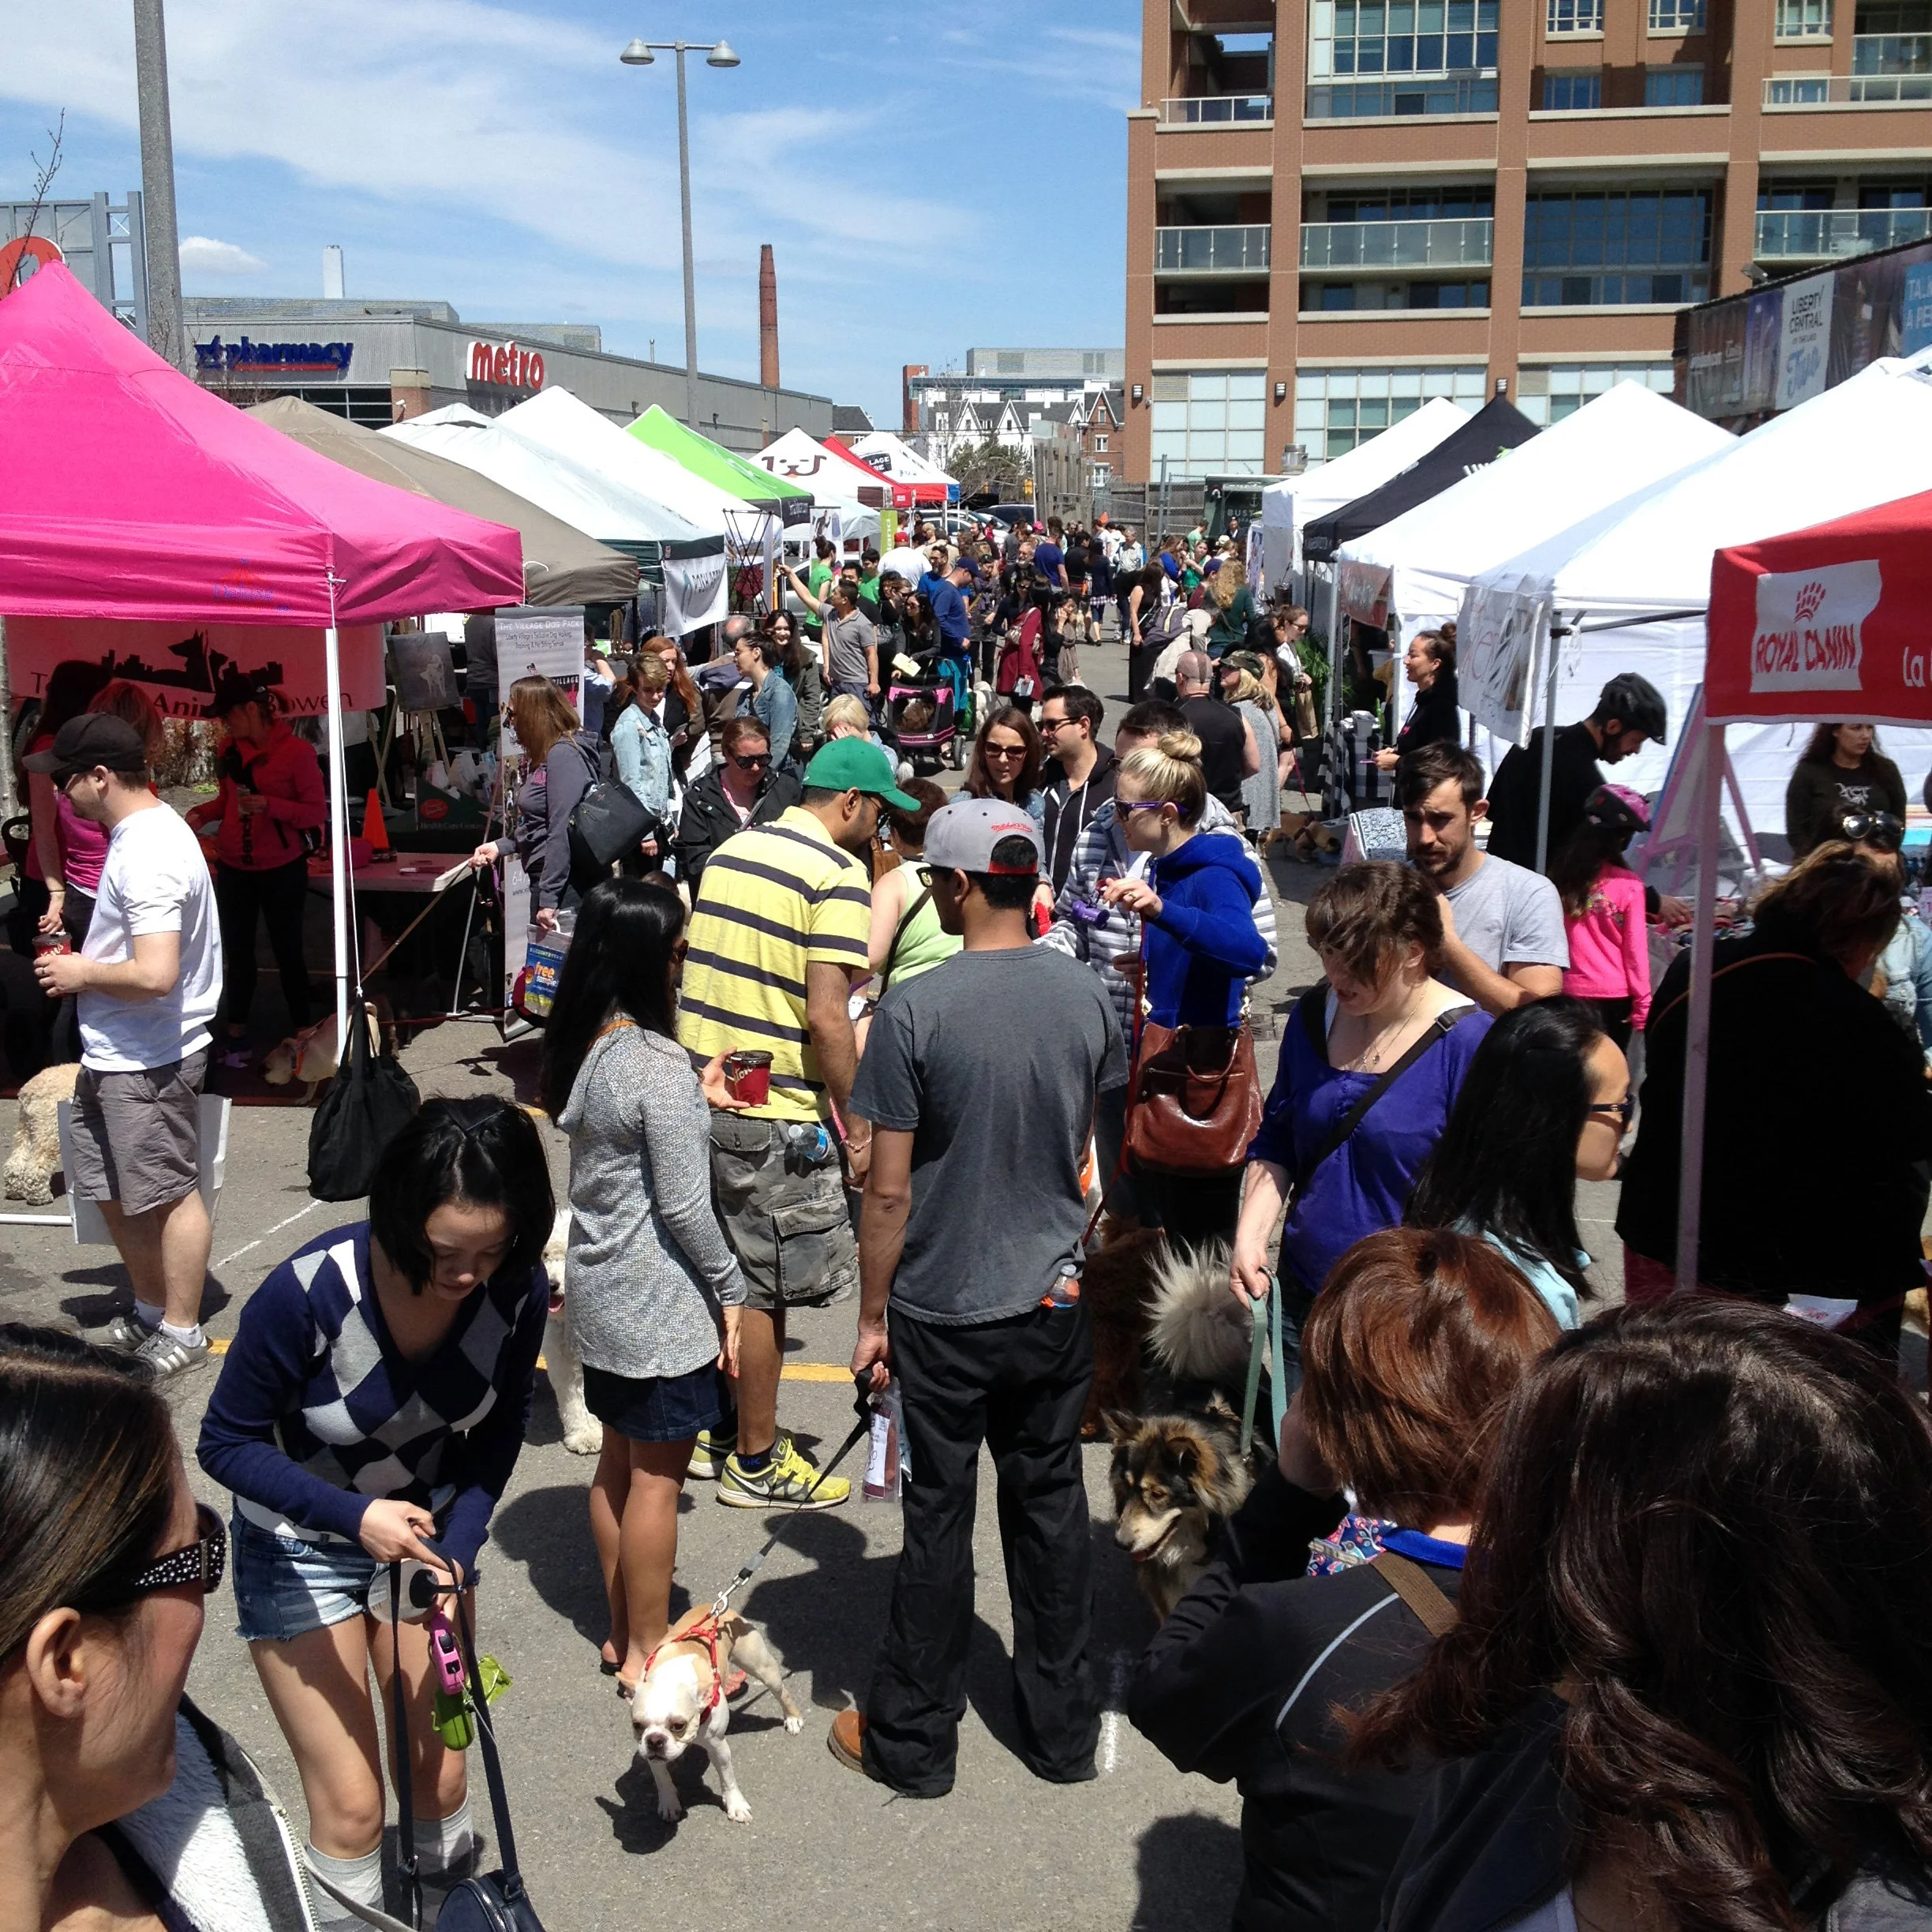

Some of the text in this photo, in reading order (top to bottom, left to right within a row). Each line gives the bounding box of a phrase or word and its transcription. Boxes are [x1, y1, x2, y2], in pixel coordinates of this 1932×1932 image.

[1792, 285, 1825, 315] LIBERTY
[1790, 310, 1823, 334] CENTRAL
[226, 335, 354, 371] pharmacy
[467, 341, 545, 390] metro
[1755, 623, 1856, 673] ROYAL CANIN
[534, 961, 556, 979] free
